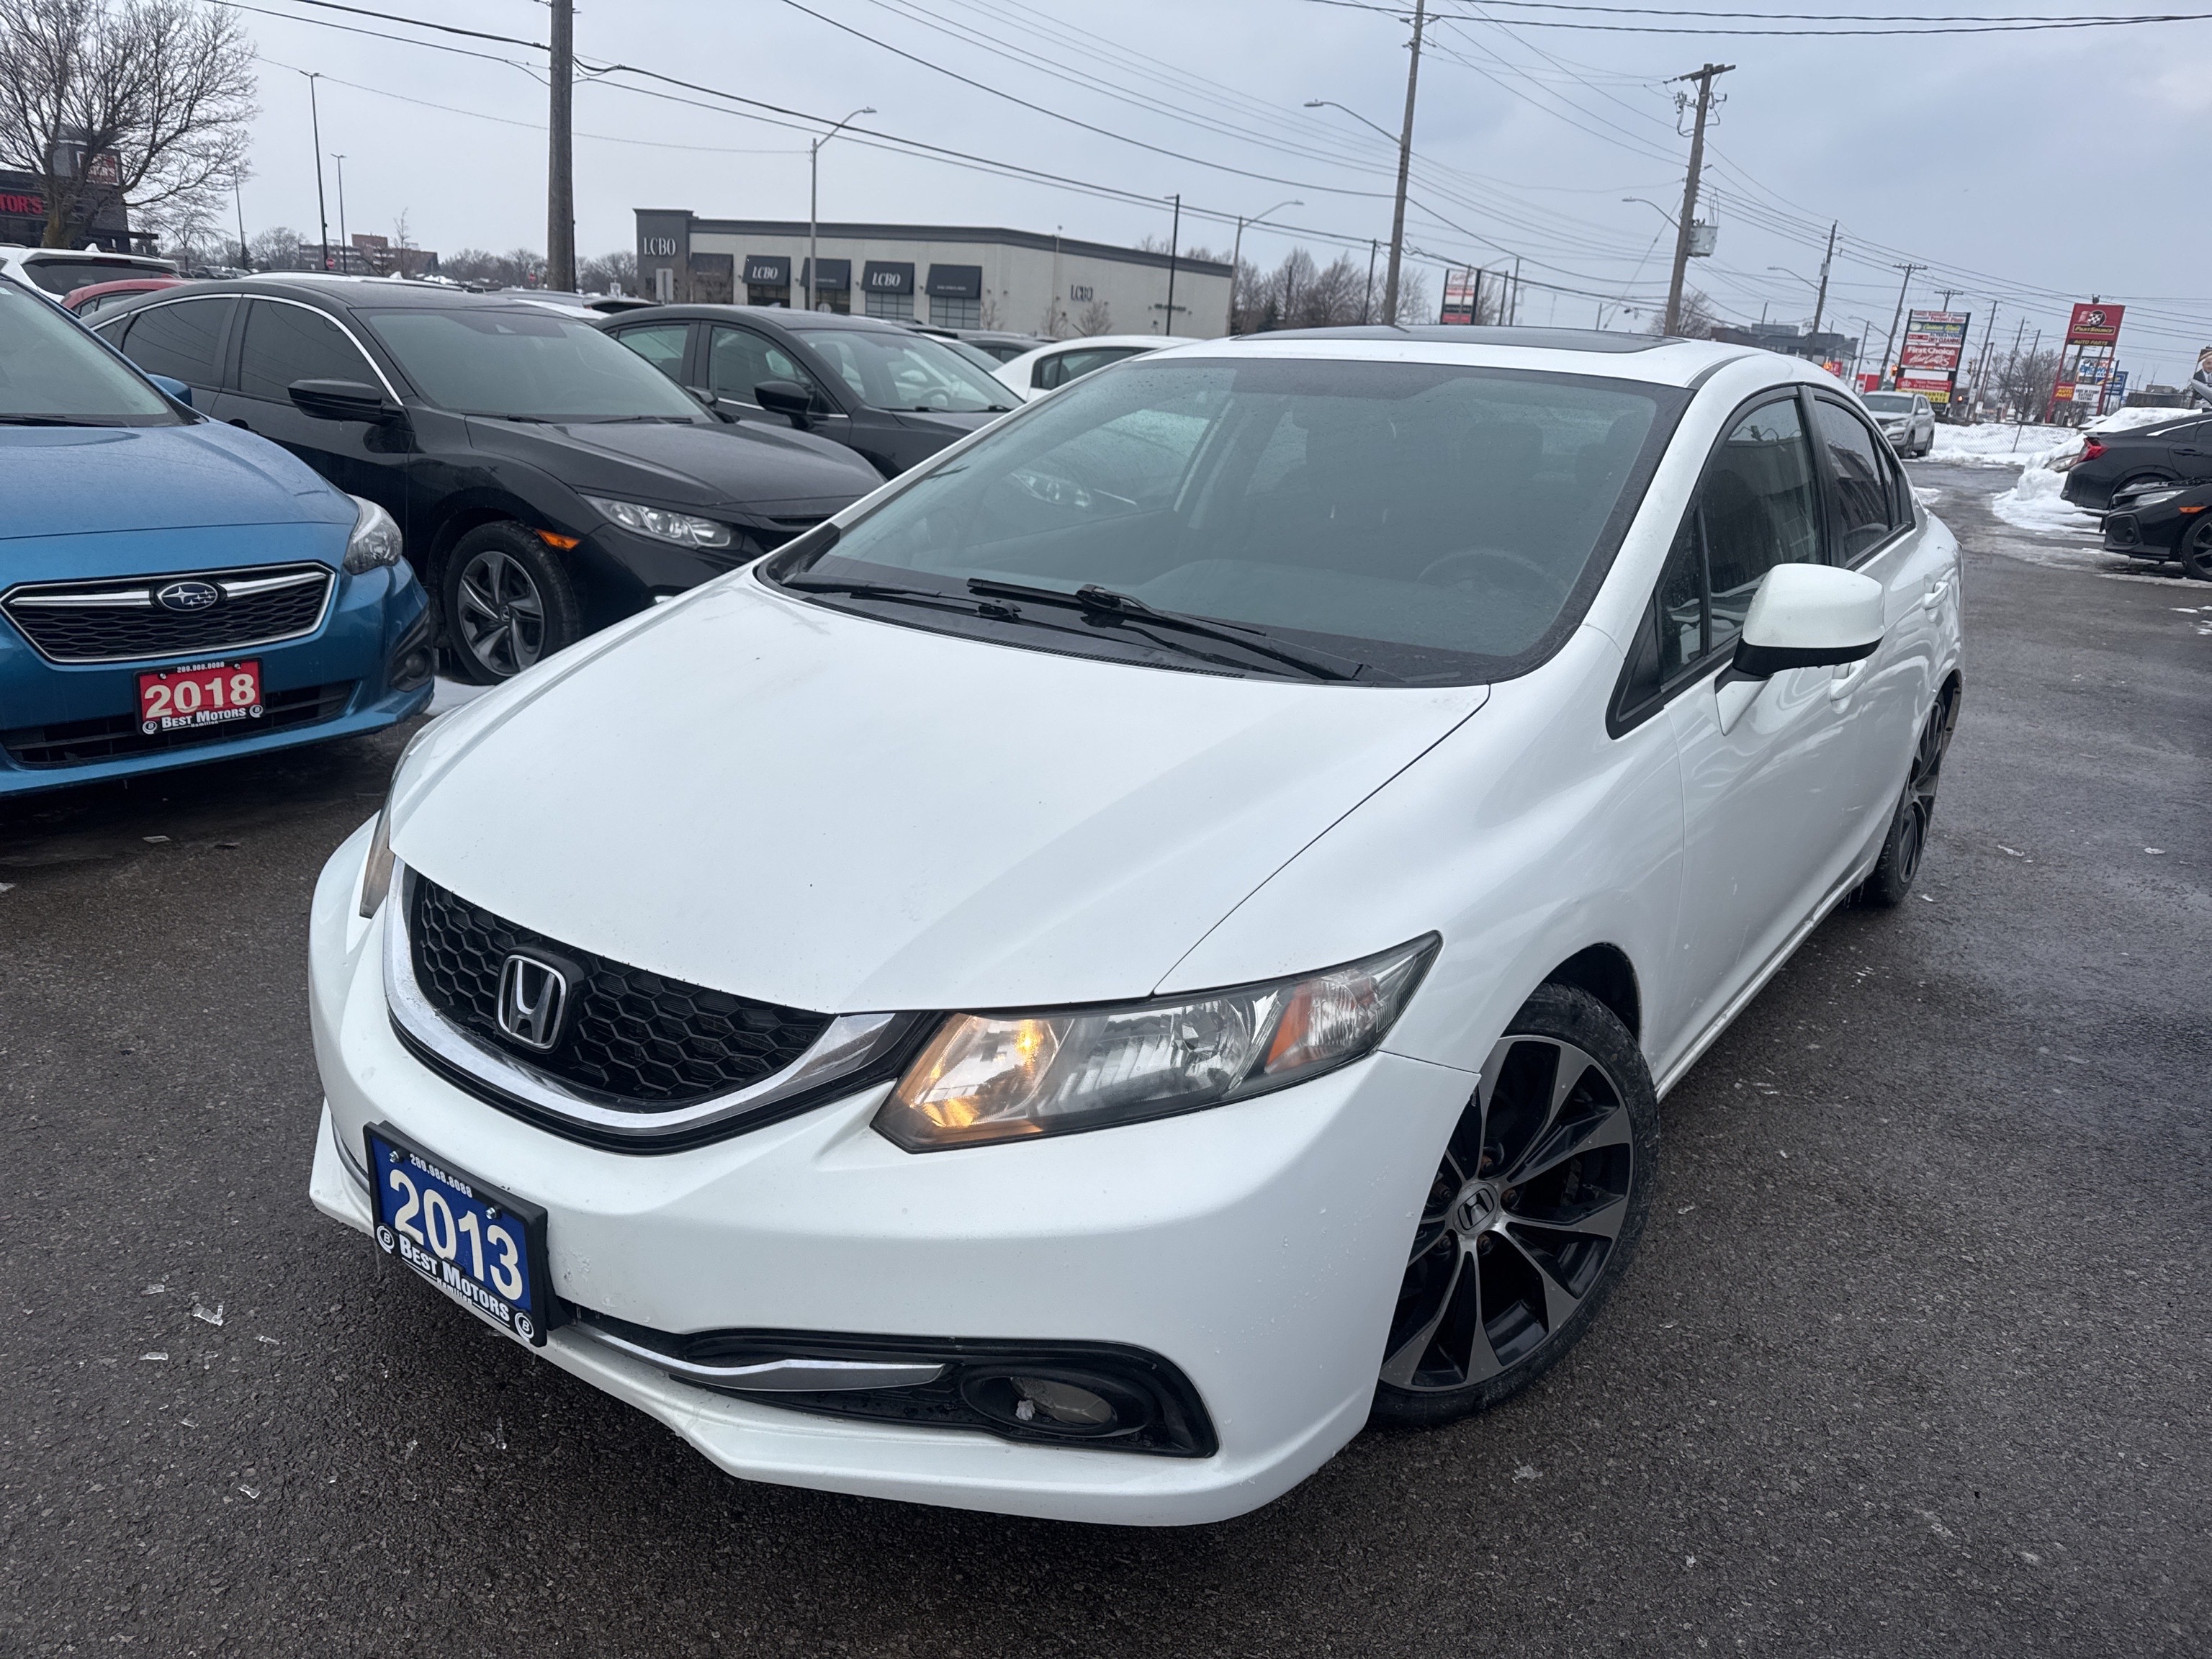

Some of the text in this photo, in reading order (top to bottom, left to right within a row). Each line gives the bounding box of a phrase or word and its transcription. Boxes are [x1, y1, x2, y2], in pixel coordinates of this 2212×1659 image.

[643, 237, 676, 256] LCBO
[752, 266, 778, 280] LCBO
[872, 271, 901, 287] LCBO
[1070, 284, 1093, 302] LCBO
[144, 673, 256, 719] 2018
[161, 708, 246, 729] BEST MOTORS
[410, 1153, 473, 1199] 289.988.8088
[390, 1168, 523, 1301] 2013
[399, 1233, 511, 1322] BEST MOTORS
[436, 1277, 473, 1305] Hamilton
